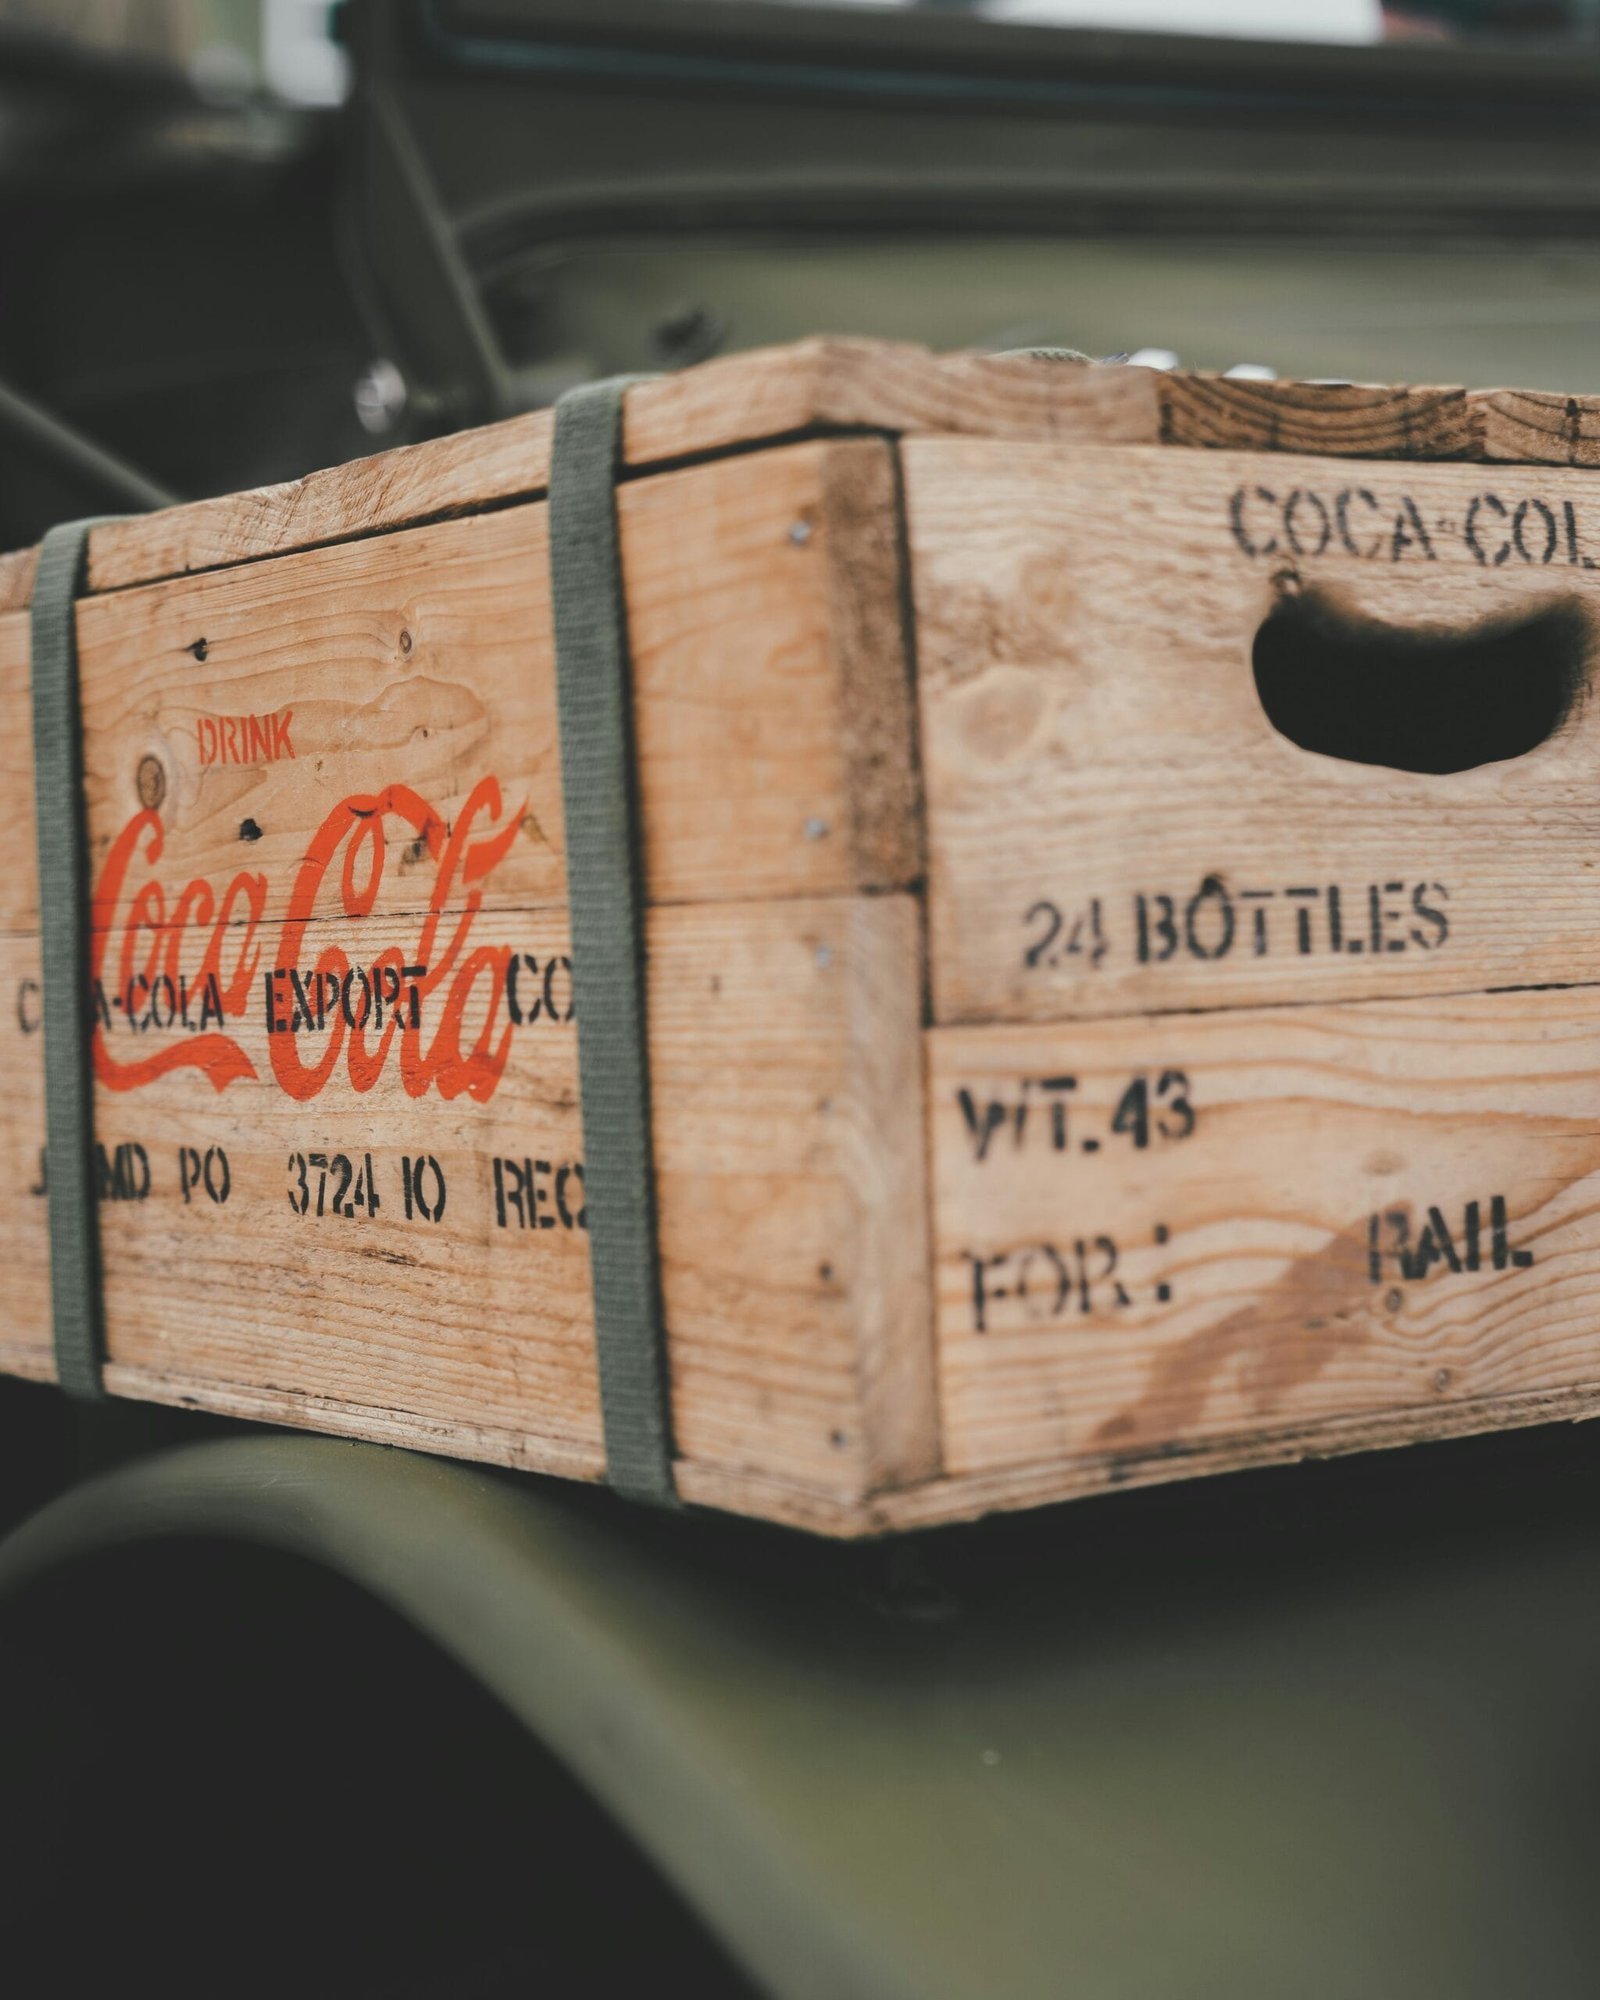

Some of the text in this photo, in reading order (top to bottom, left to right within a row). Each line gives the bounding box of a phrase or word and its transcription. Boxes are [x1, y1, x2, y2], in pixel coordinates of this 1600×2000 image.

[197, 710, 296, 765] DRINK
[268, 775, 530, 1103] Cola
[1023, 882, 1450, 968] 24 BOTTLES
[264, 965, 428, 1034] EXPORT
[179, 1144, 231, 1204] PO
[288, 1152, 380, 1218] 3724
[1369, 1195, 1534, 1286] RAIL
